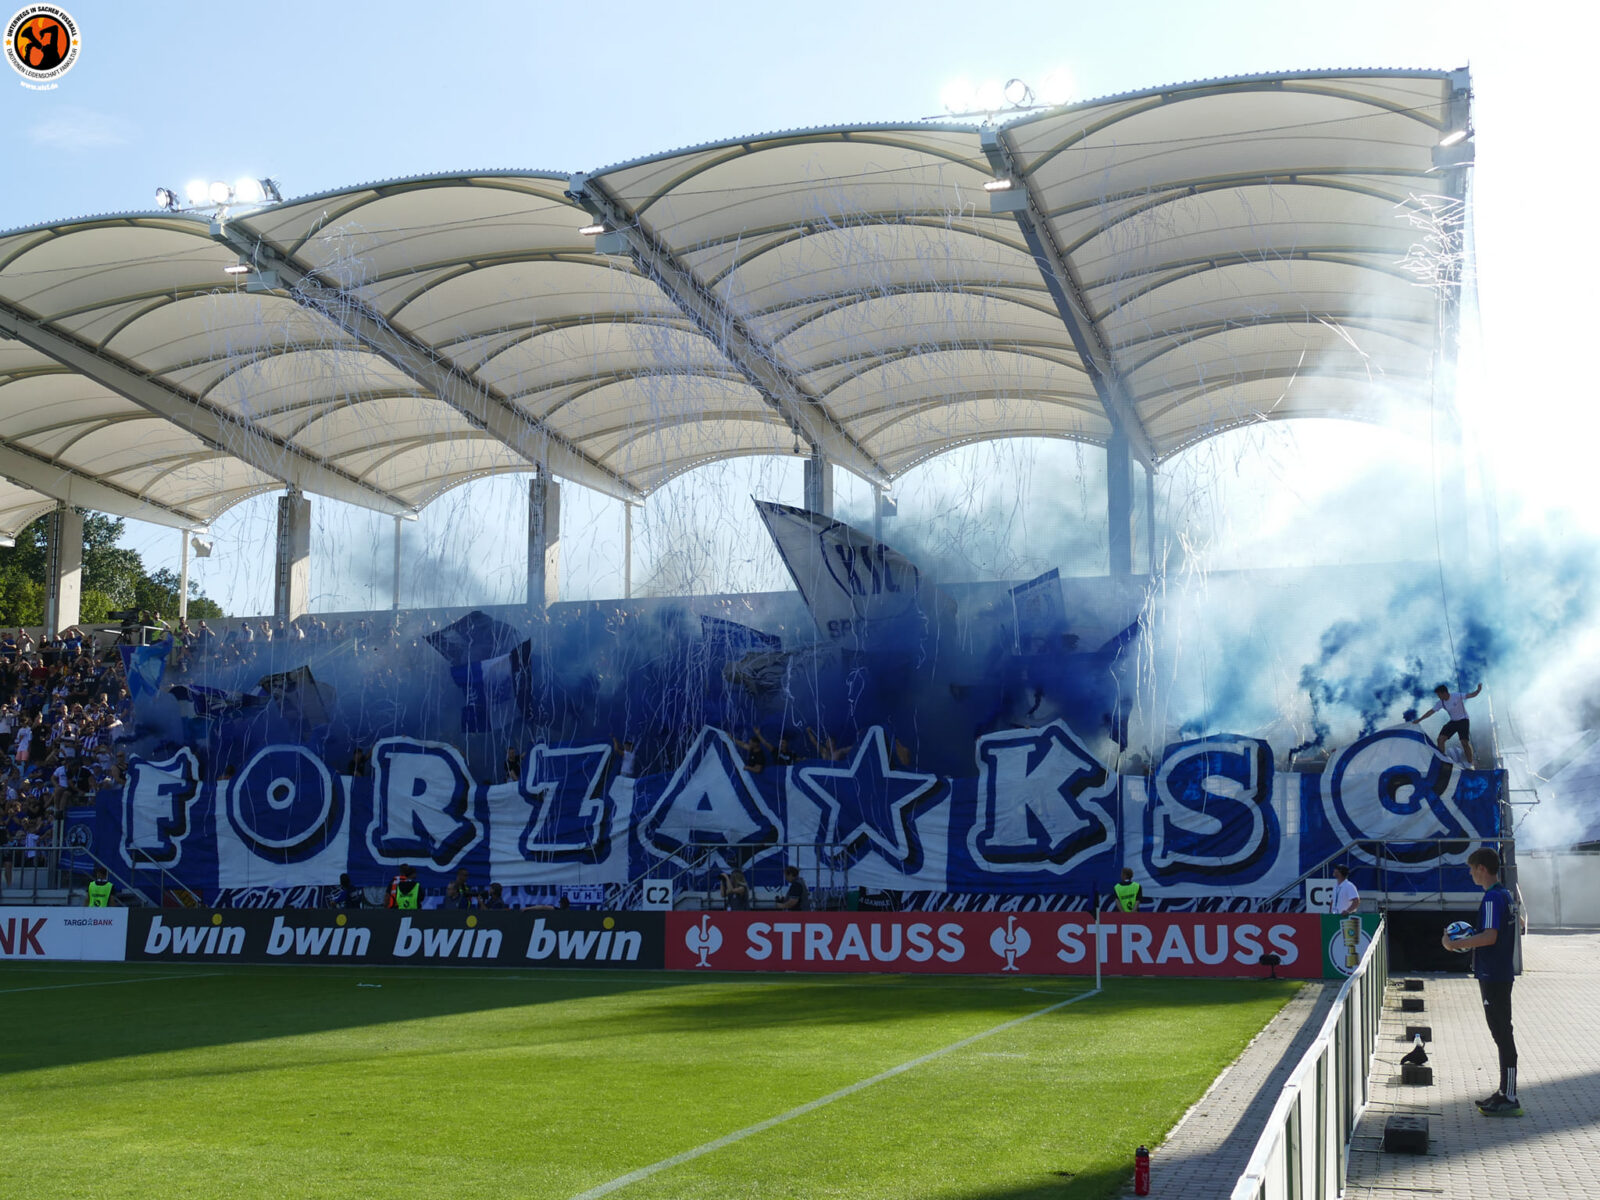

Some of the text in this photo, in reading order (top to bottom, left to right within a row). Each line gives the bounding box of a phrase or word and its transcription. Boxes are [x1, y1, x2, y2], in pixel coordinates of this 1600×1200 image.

[119, 718, 1482, 877] FORZA KSC
[646, 886, 671, 905] C2
[145, 915, 245, 954] bwin
[266, 915, 371, 956] bwin
[393, 916, 503, 958] bwin
[526, 917, 642, 961] bwin
[745, 922, 965, 963] STRAUSS
[1057, 923, 1299, 965] STRAUSS
